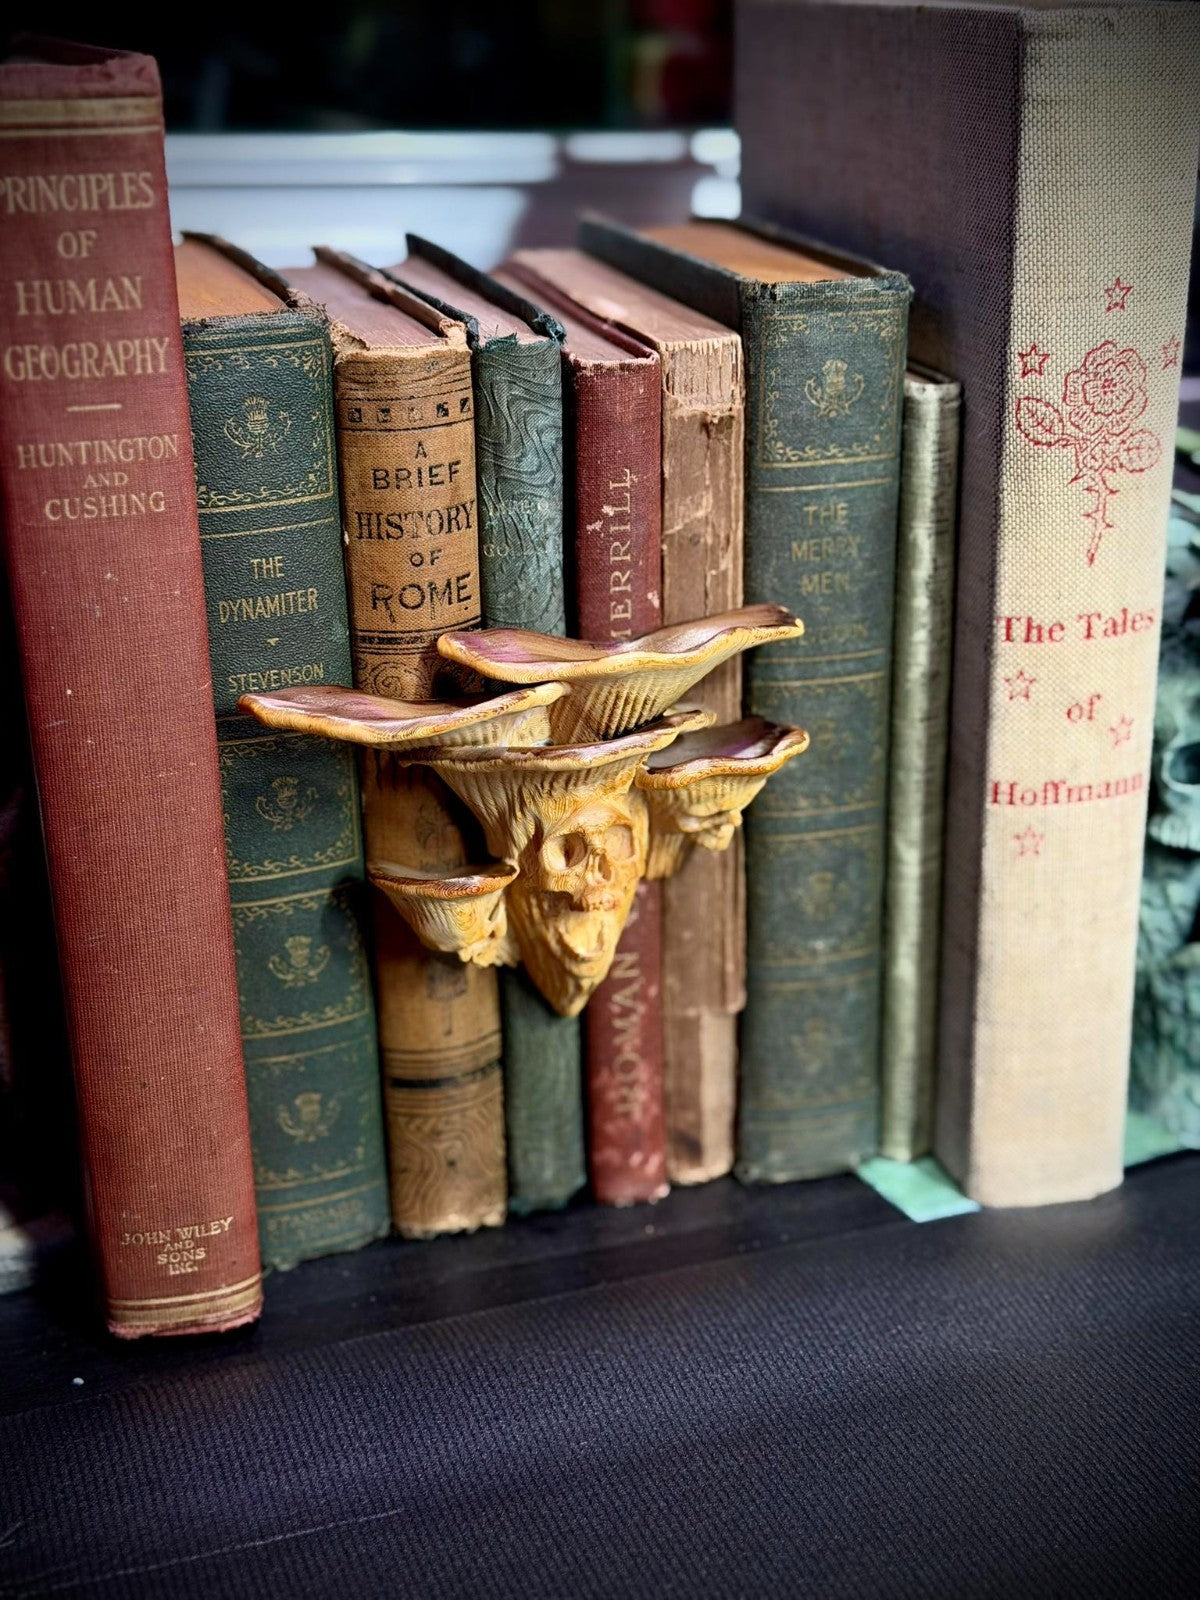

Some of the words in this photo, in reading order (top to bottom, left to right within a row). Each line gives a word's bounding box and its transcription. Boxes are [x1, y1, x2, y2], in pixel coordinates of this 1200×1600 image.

[57, 229, 98, 259] OF
[14, 275, 143, 316] HUMAN
[4, 337, 170, 381] GEOGRAPHY
[17, 434, 179, 469] HUNTINGTON
[415, 441, 428, 459] A
[83, 472, 129, 488] AND
[371, 460, 462, 490] BRIEF
[45, 491, 166, 521] CUSHING
[355, 500, 475, 541] HISTORY
[803, 501, 849, 527] THE
[251, 556, 285, 579] THE
[409, 549, 444, 567] OF
[219, 588, 319, 624] DYNAMITER
[371, 572, 473, 623] ROME
[996, 615, 1066, 644] The
[1077, 607, 1157, 641] Tales
[228, 663, 325, 693] STEVENSON
[1066, 693, 1103, 724] of
[990, 773, 1144, 807] Hoffmann
[121, 1229, 172, 1246] JOHN
[175, 1216, 234, 1240] WILEY
[164, 1239, 195, 1252] AND
[157, 1247, 206, 1265] SONS
